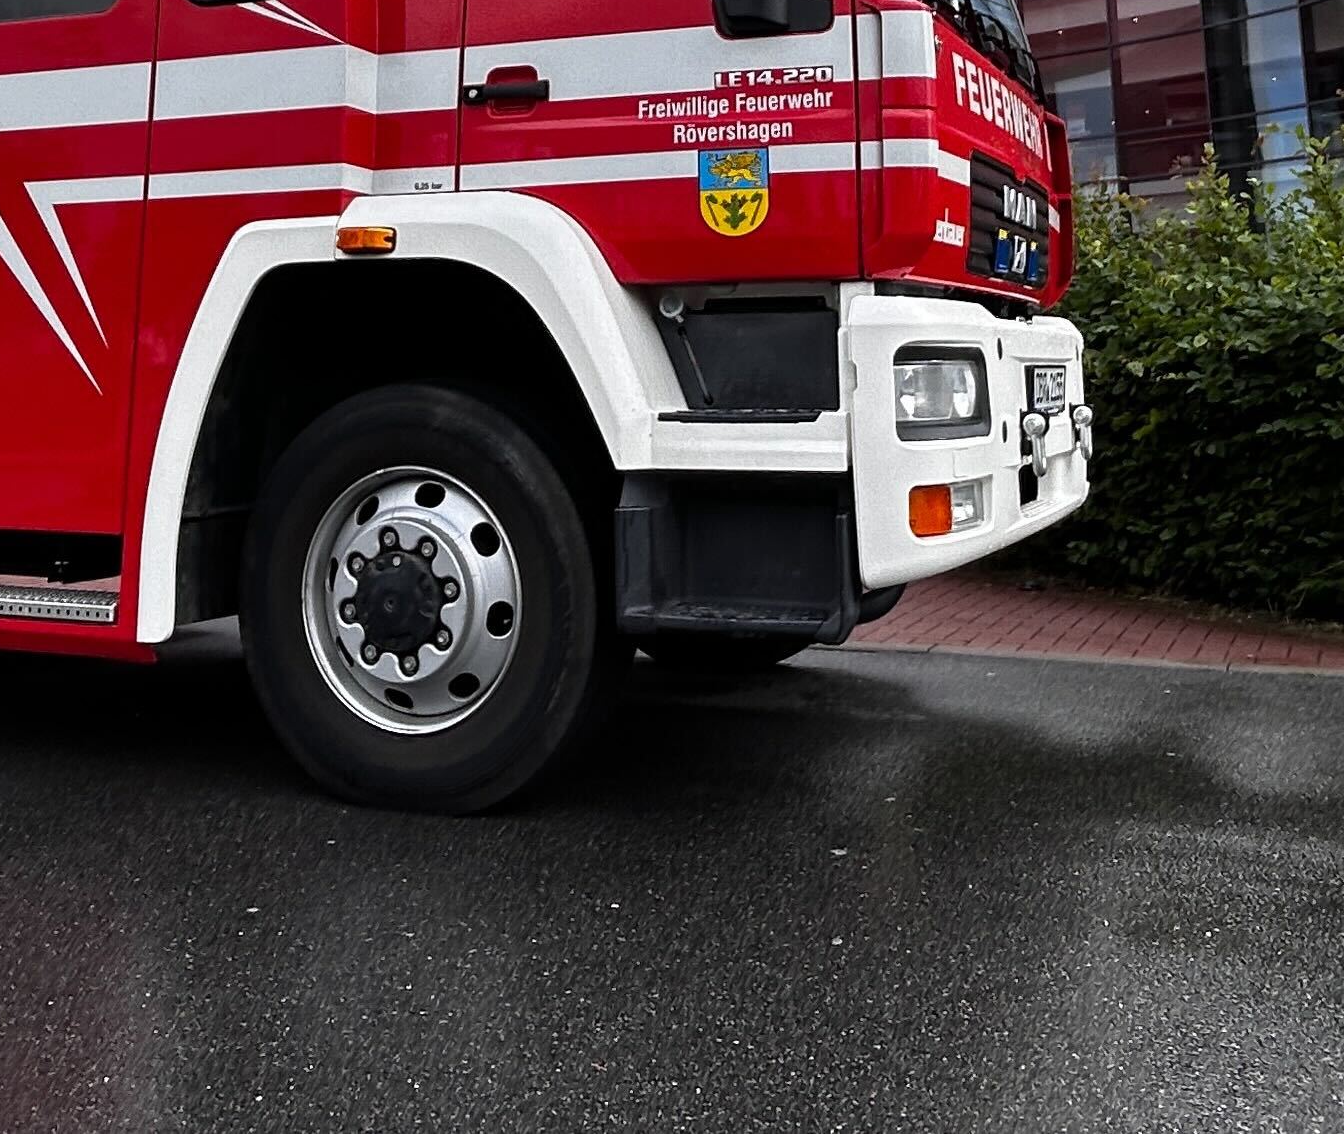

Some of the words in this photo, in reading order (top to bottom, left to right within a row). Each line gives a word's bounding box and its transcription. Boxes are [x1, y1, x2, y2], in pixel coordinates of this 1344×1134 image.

[638, 95, 730, 119] Freiwillige
[735, 88, 834, 114] Feuerwehr
[951, 51, 1044, 160] FEUERWEHR
[672, 120, 794, 144] Rövershagen
[1003, 184, 1037, 230] MAN
